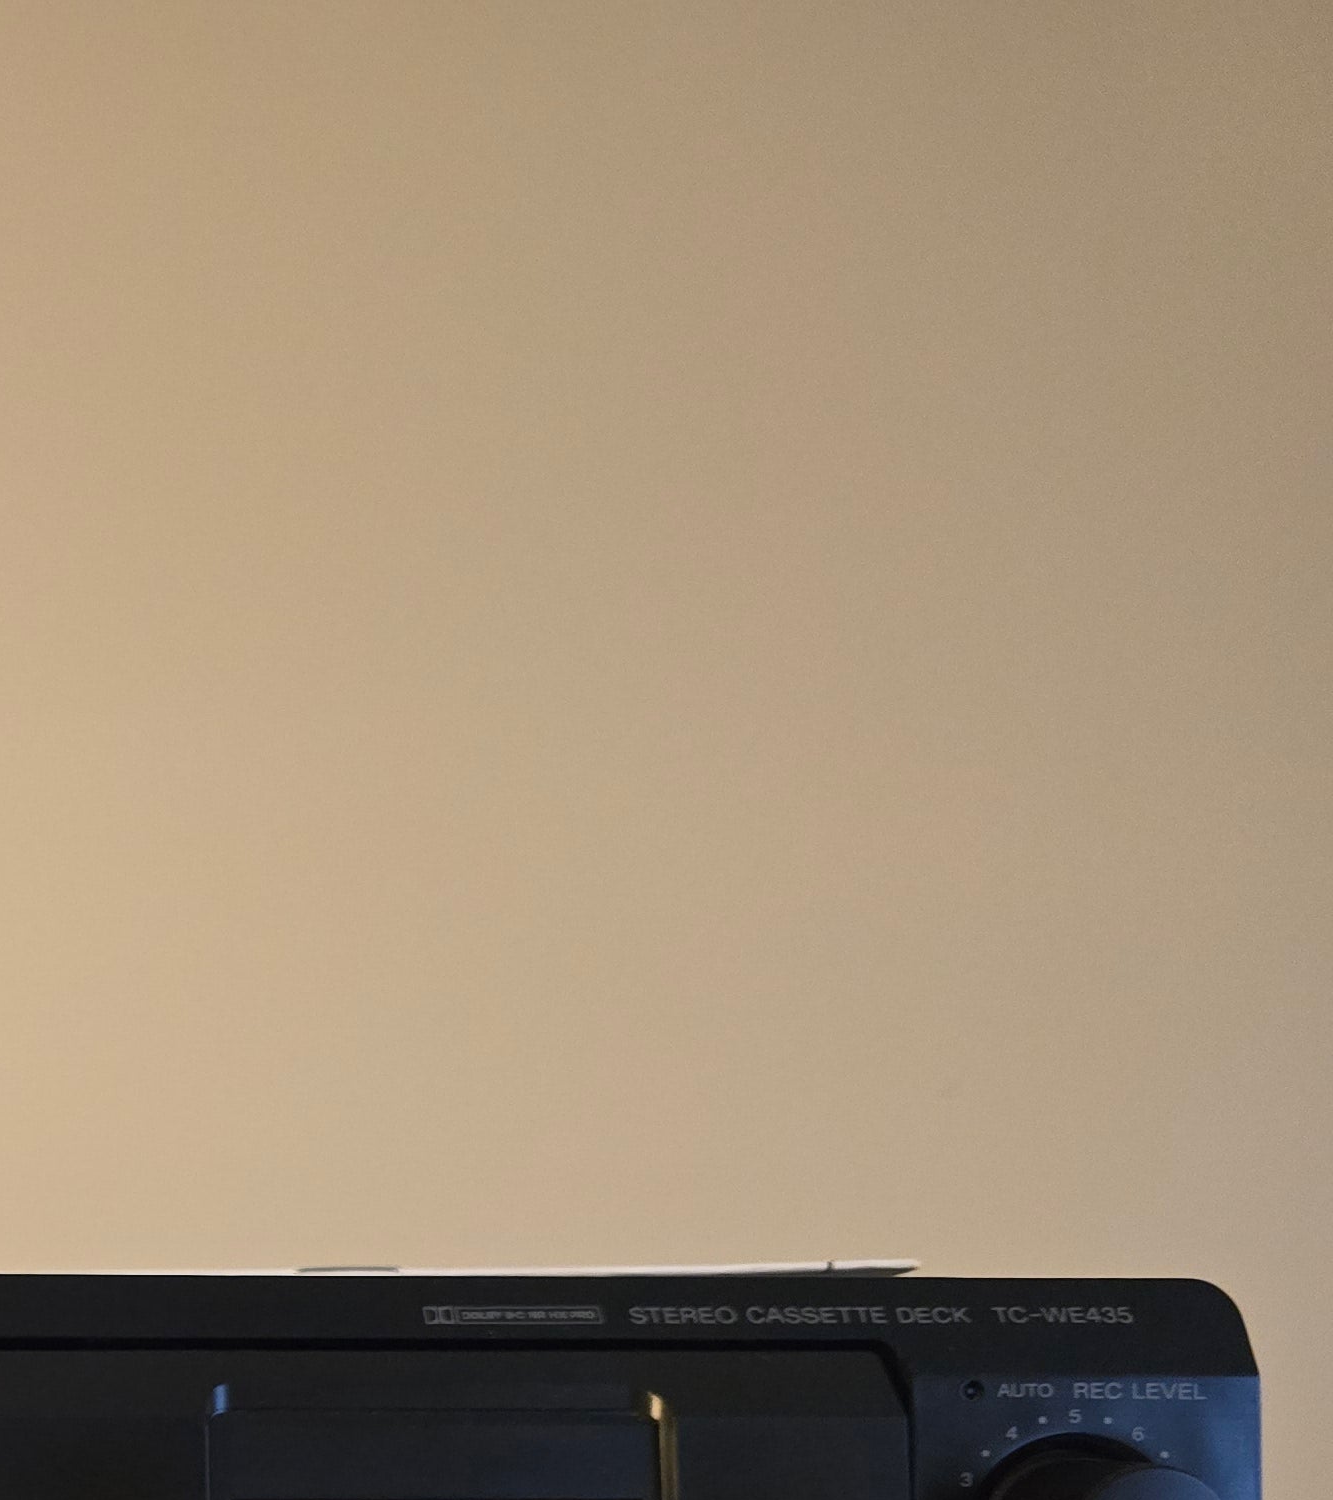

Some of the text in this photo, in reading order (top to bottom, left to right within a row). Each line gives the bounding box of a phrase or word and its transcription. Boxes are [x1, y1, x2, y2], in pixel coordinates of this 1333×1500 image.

[629, 1306, 972, 1325] STEREO CASSETTE DECK
[991, 1306, 1133, 1324] TC-WE435
[997, 1383, 1054, 1399] AUTO
[1074, 1383, 1207, 1400] REC LEVEL
[1068, 1410, 1082, 1423] 5
[1005, 1427, 1019, 1440] 4
[1132, 1427, 1146, 1442] 6
[959, 1472, 974, 1488] 3
